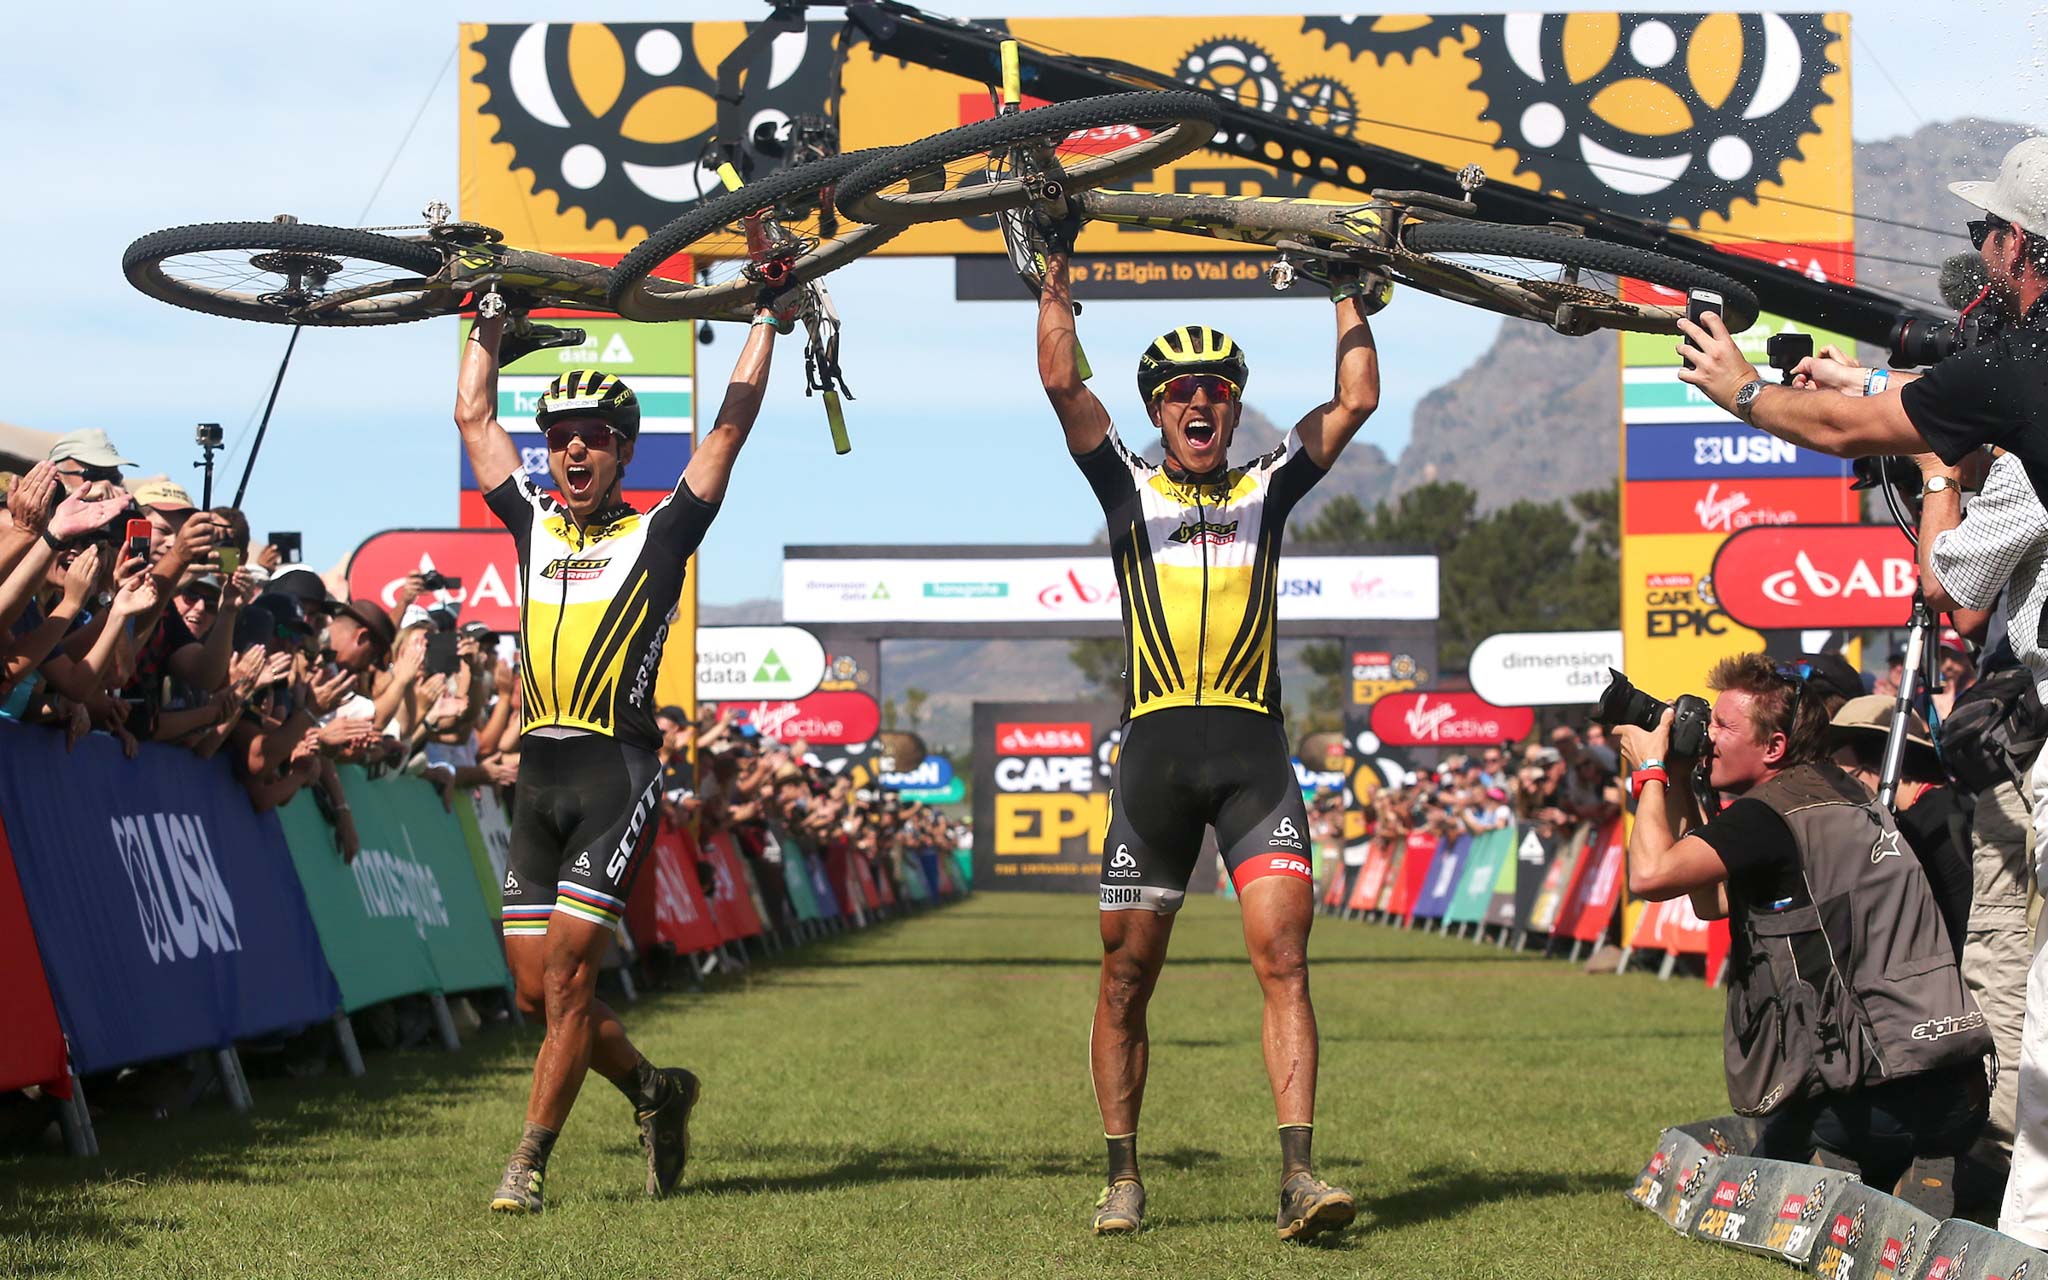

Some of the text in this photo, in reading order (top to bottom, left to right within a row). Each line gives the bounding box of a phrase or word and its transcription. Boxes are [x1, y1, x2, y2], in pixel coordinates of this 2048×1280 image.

[1092, 263, 1112, 281] 7:
[1114, 261, 1167, 284] Elgin
[1172, 264, 1193, 280] to
[1195, 261, 1228, 280] Val
[1232, 261, 1259, 280] de
[1720, 437, 1797, 463] USN
[1695, 483, 1750, 530] Virgin
[1734, 506, 1798, 526] active
[558, 560, 609, 568] SCOTT
[557, 571, 601, 580] SRAM
[1647, 609, 1727, 637] EPIC
[1502, 651, 1614, 669] dimension
[700, 667, 747, 684] data
[1566, 669, 1613, 687] data
[749, 701, 800, 739] Virgin
[784, 717, 843, 737] active
[1404, 694, 1457, 741] Virgin
[1440, 718, 1499, 738] active
[1032, 730, 1085, 749] ABSA
[994, 756, 1094, 792] CAPE
[605, 766, 663, 886] SCOTT
[994, 792, 1109, 855] EPI
[1268, 838, 1303, 849] odlo
[572, 867, 591, 877] odlo
[1108, 869, 1142, 878] odlo
[136, 813, 242, 959] USN
[1911, 1011, 1985, 1040] alpinesta
[1698, 1207, 1729, 1237] CAPE
[1720, 1212, 1747, 1241] EPIC
